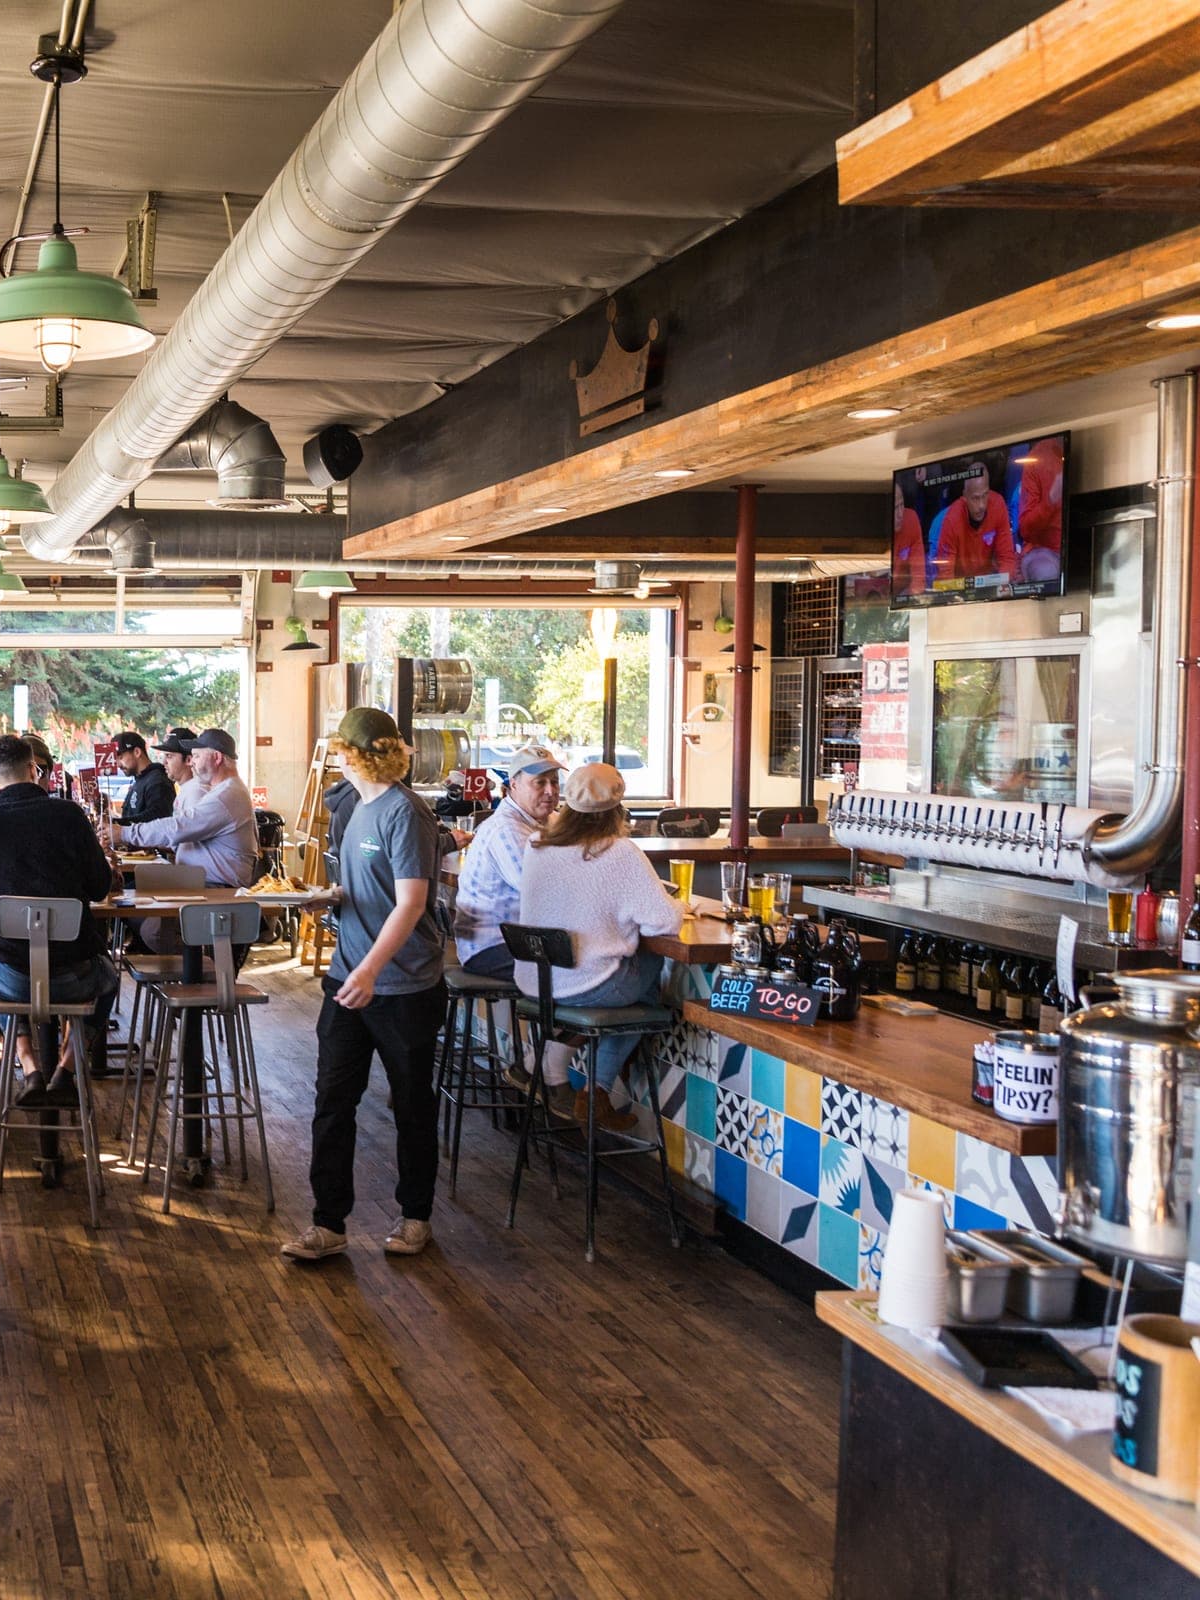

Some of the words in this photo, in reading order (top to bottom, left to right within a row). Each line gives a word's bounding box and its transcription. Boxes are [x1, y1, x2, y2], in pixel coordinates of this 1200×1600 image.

[96, 752, 116, 767] 74
[465, 776, 486, 793] 19
[845, 771, 856, 784] 89
[253, 793, 266, 803] 96
[721, 980, 753, 994] COLD
[711, 993, 750, 1012] BEER
[756, 988, 811, 1013] TO-GO
[995, 1079, 1053, 1114] TIPSY?
